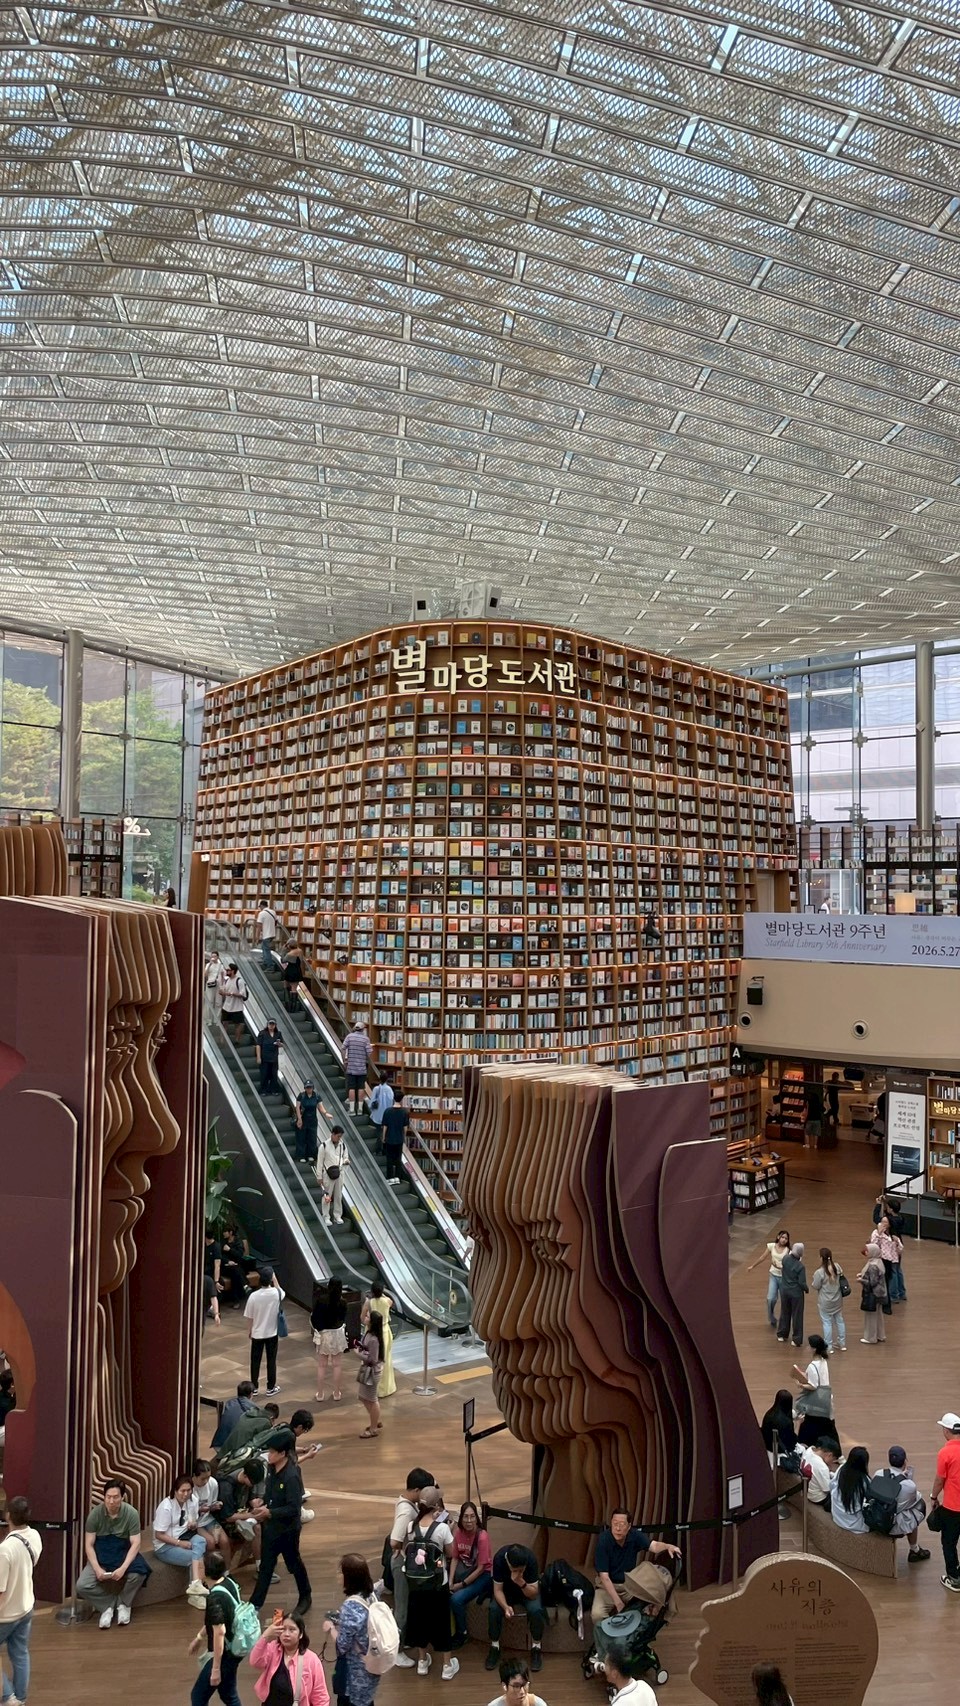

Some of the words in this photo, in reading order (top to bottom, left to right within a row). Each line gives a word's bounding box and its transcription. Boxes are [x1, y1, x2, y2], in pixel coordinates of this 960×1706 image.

[391, 640, 493, 695] 별마당
[497, 658, 577, 694] 도서관
[765, 921, 846, 938] 별마당도서관
[850, 923, 886, 940] 9주년
[765, 938, 795, 948] Starfield
[796, 939, 824, 951] Library
[826, 939, 839, 949] 9th
[840, 941, 887, 953] Anniversary
[911, 944, 960, 957] 2026.5.27
[732, 1047, 741, 1058] A
[770, 1577, 822, 1597] 사유의
[801, 1598, 836, 1616] 지층
